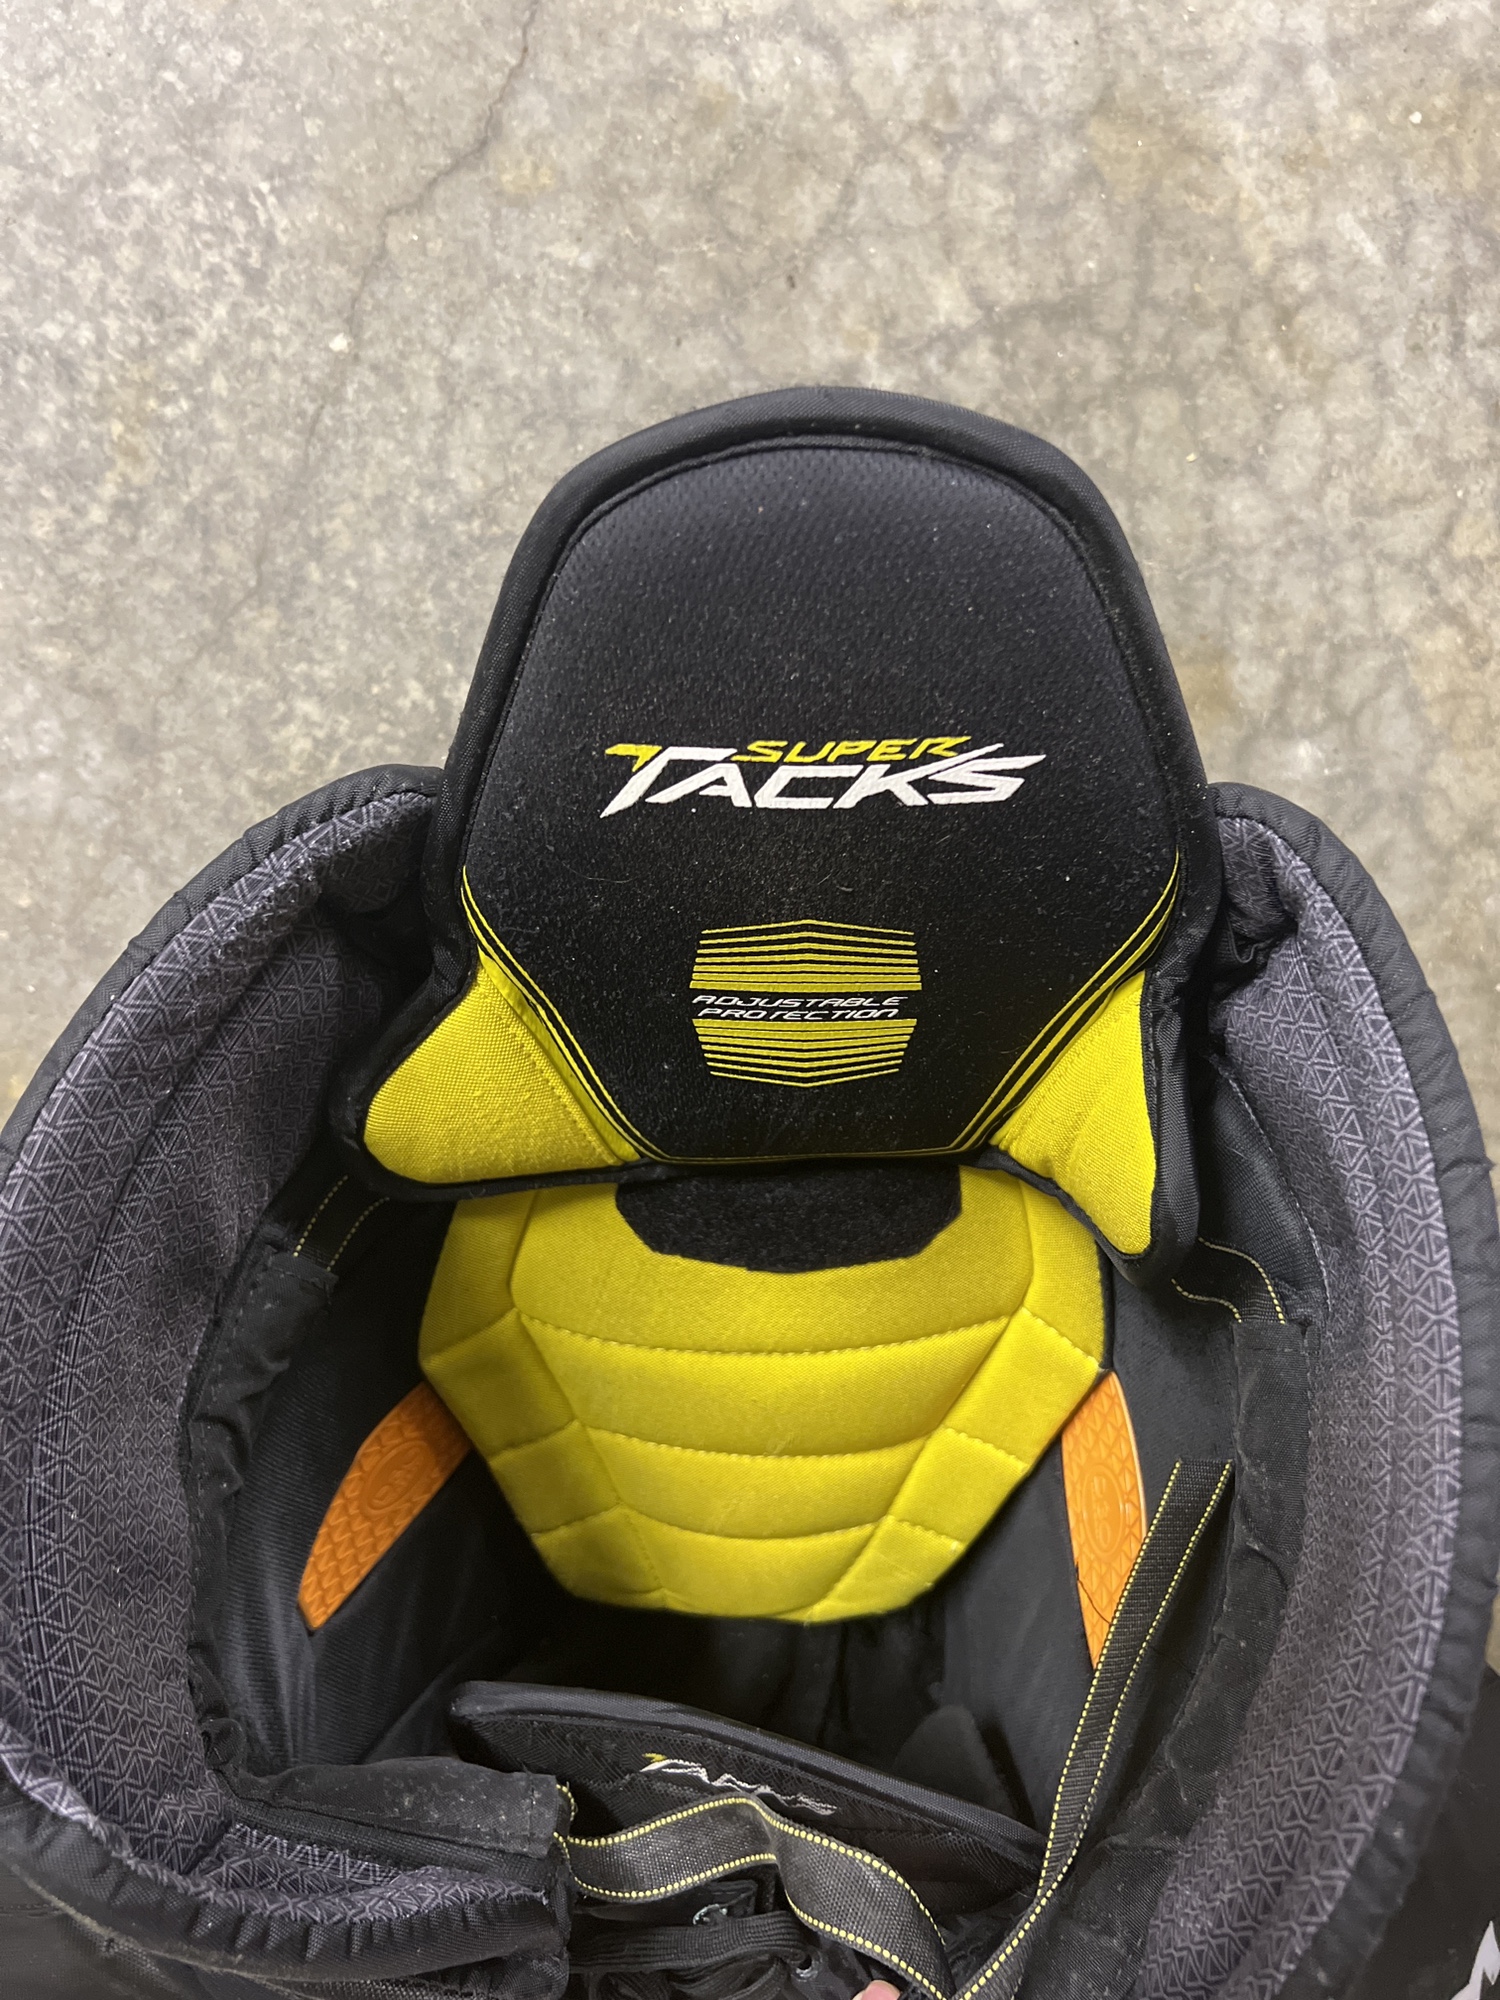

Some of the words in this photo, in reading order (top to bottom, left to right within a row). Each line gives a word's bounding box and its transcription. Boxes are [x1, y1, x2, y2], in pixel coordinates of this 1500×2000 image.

[731, 735, 972, 763] SUPER
[600, 743, 1046, 819] TACKS
[692, 995, 908, 1008] ADJUSTABLE
[698, 1007, 899, 1020] PROTECTION
